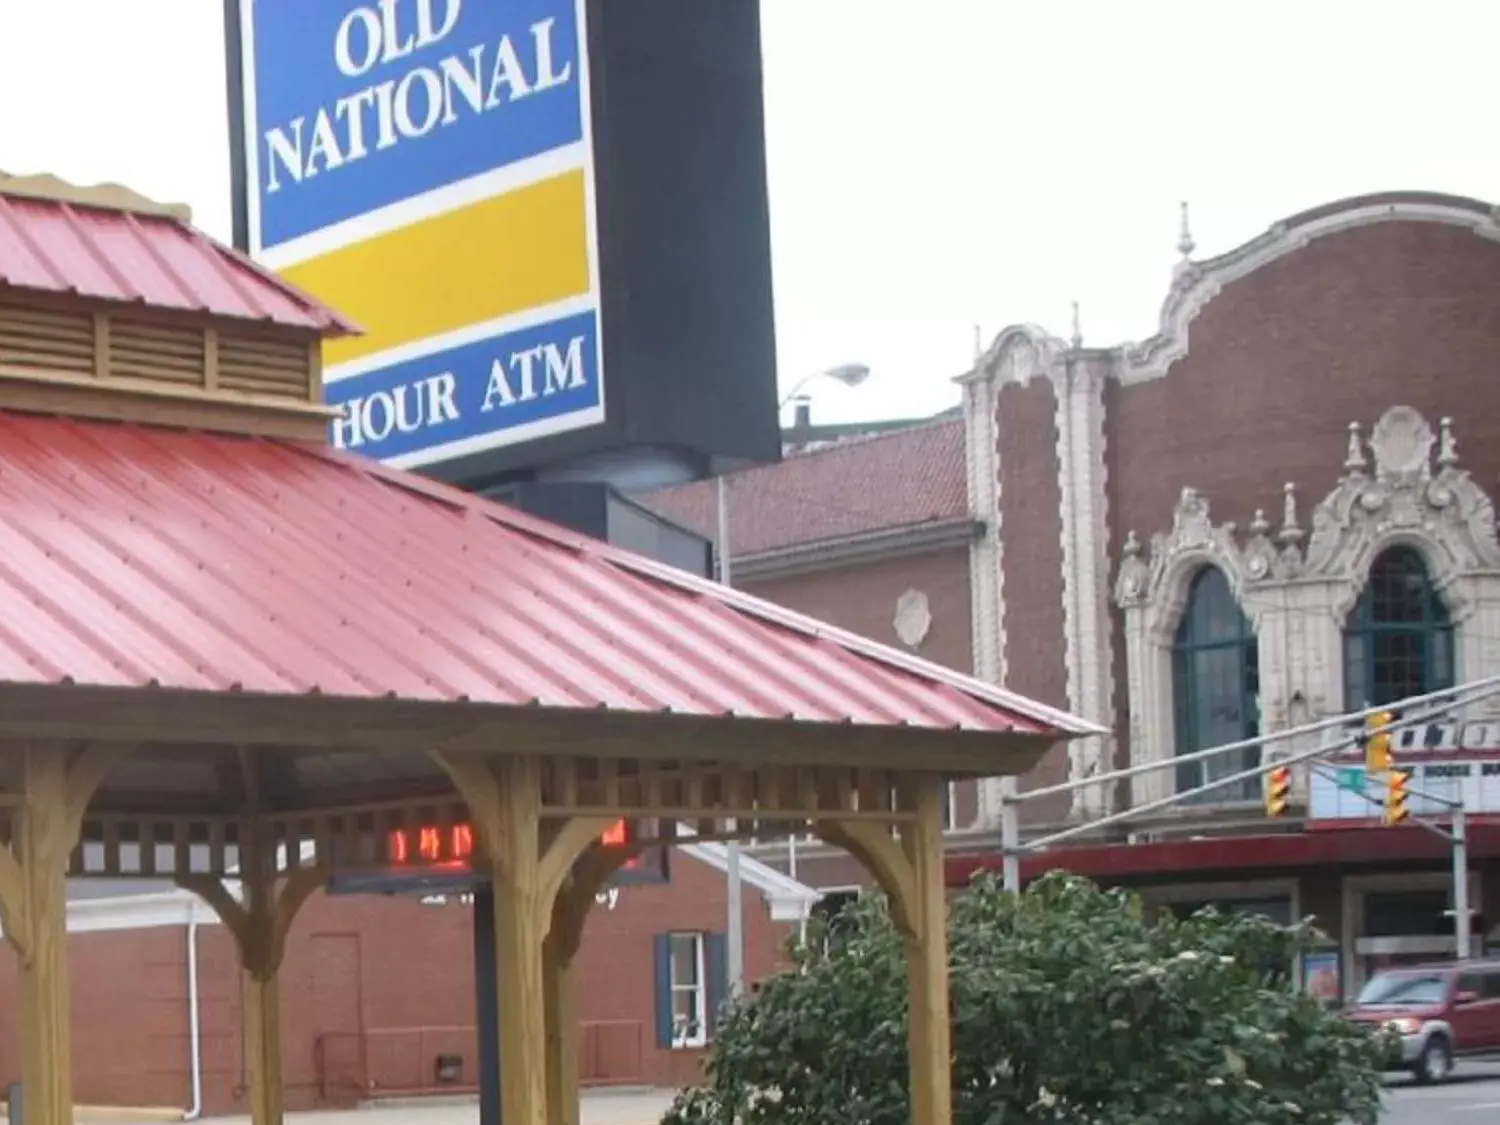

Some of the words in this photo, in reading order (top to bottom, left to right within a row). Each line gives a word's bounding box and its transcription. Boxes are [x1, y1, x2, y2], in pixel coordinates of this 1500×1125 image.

[334, 0, 462, 77] OLD
[264, 17, 571, 193] NATIONAL
[332, 371, 460, 448] HOUR
[480, 336, 588, 412] ATM
